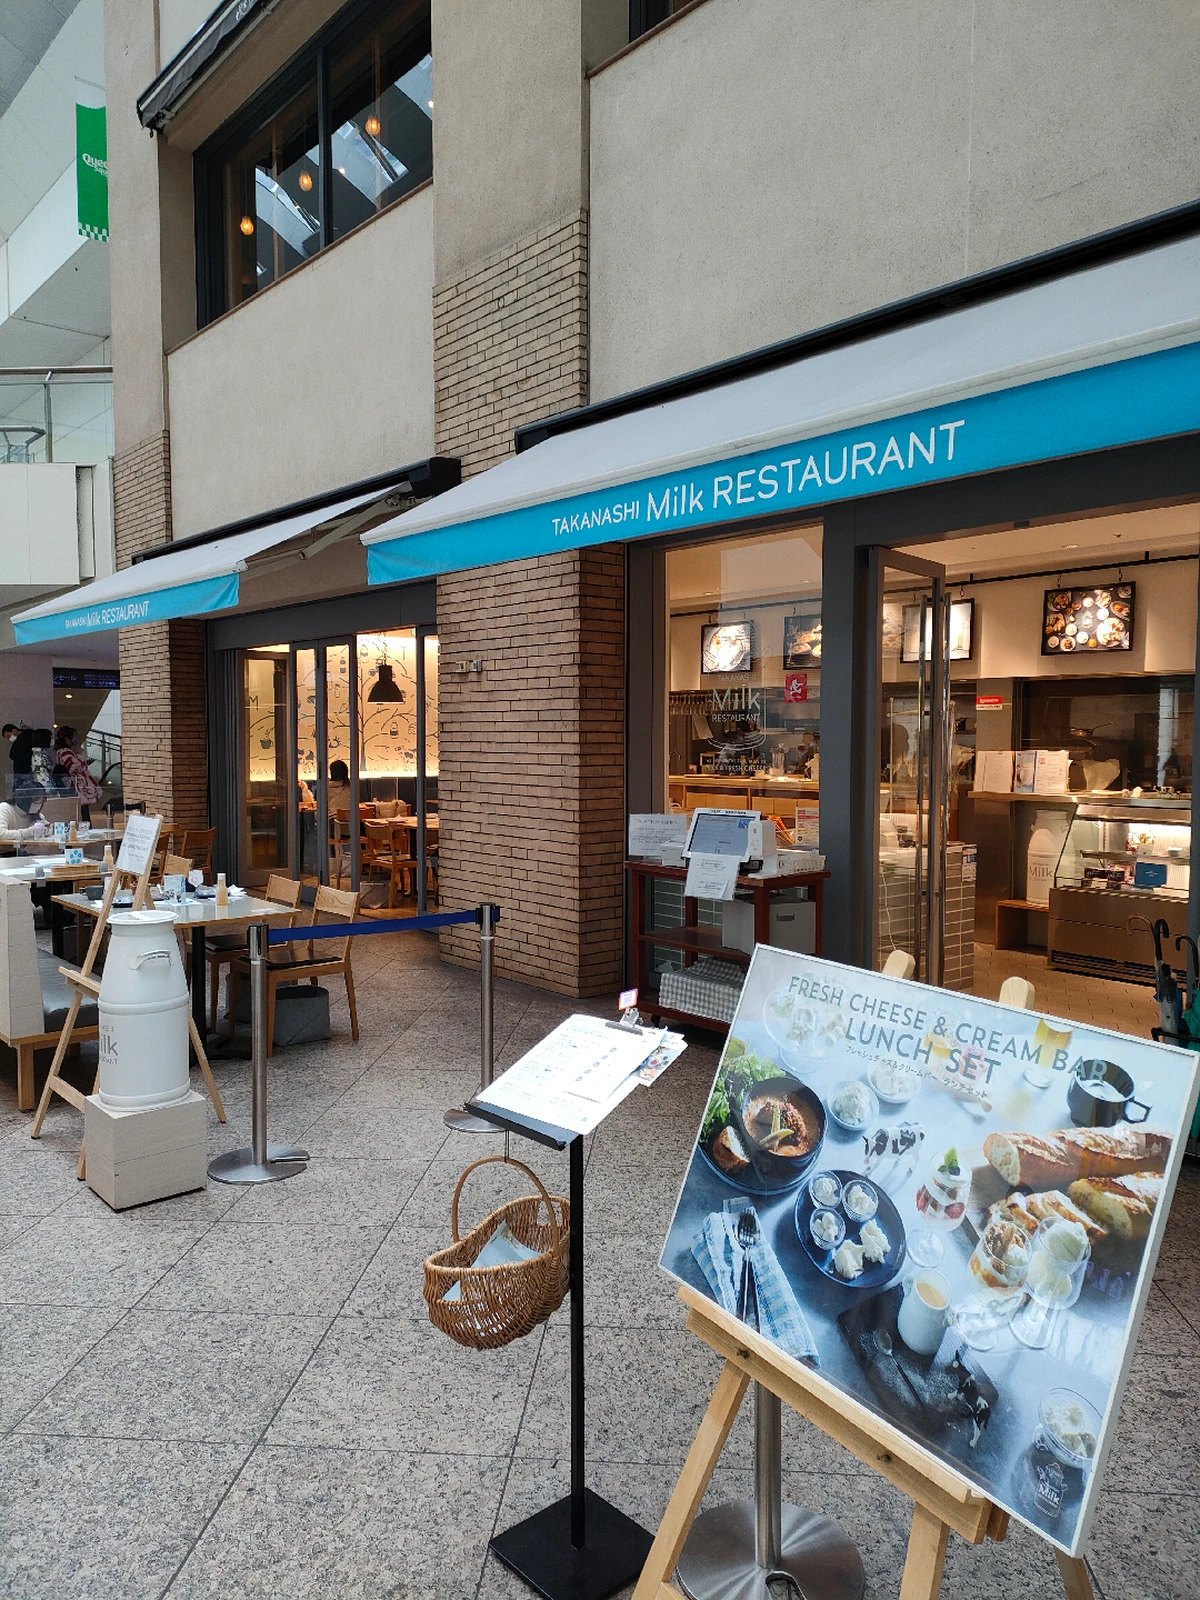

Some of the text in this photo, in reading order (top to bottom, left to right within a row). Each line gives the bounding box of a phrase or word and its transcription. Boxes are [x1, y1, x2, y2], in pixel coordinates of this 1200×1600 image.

[552, 419, 966, 536] TAKANASHI Milk RESTAURANT
[87, 613, 101, 627] Milk
[102, 601, 150, 624] RESTAURANT
[712, 685, 760, 710] Milk
[712, 714, 760, 723] RESTAURANT
[788, 976, 1108, 1083] FRESH CHEESE & CREAM BAR
[845, 1018, 1002, 1085] LUNCH SET
